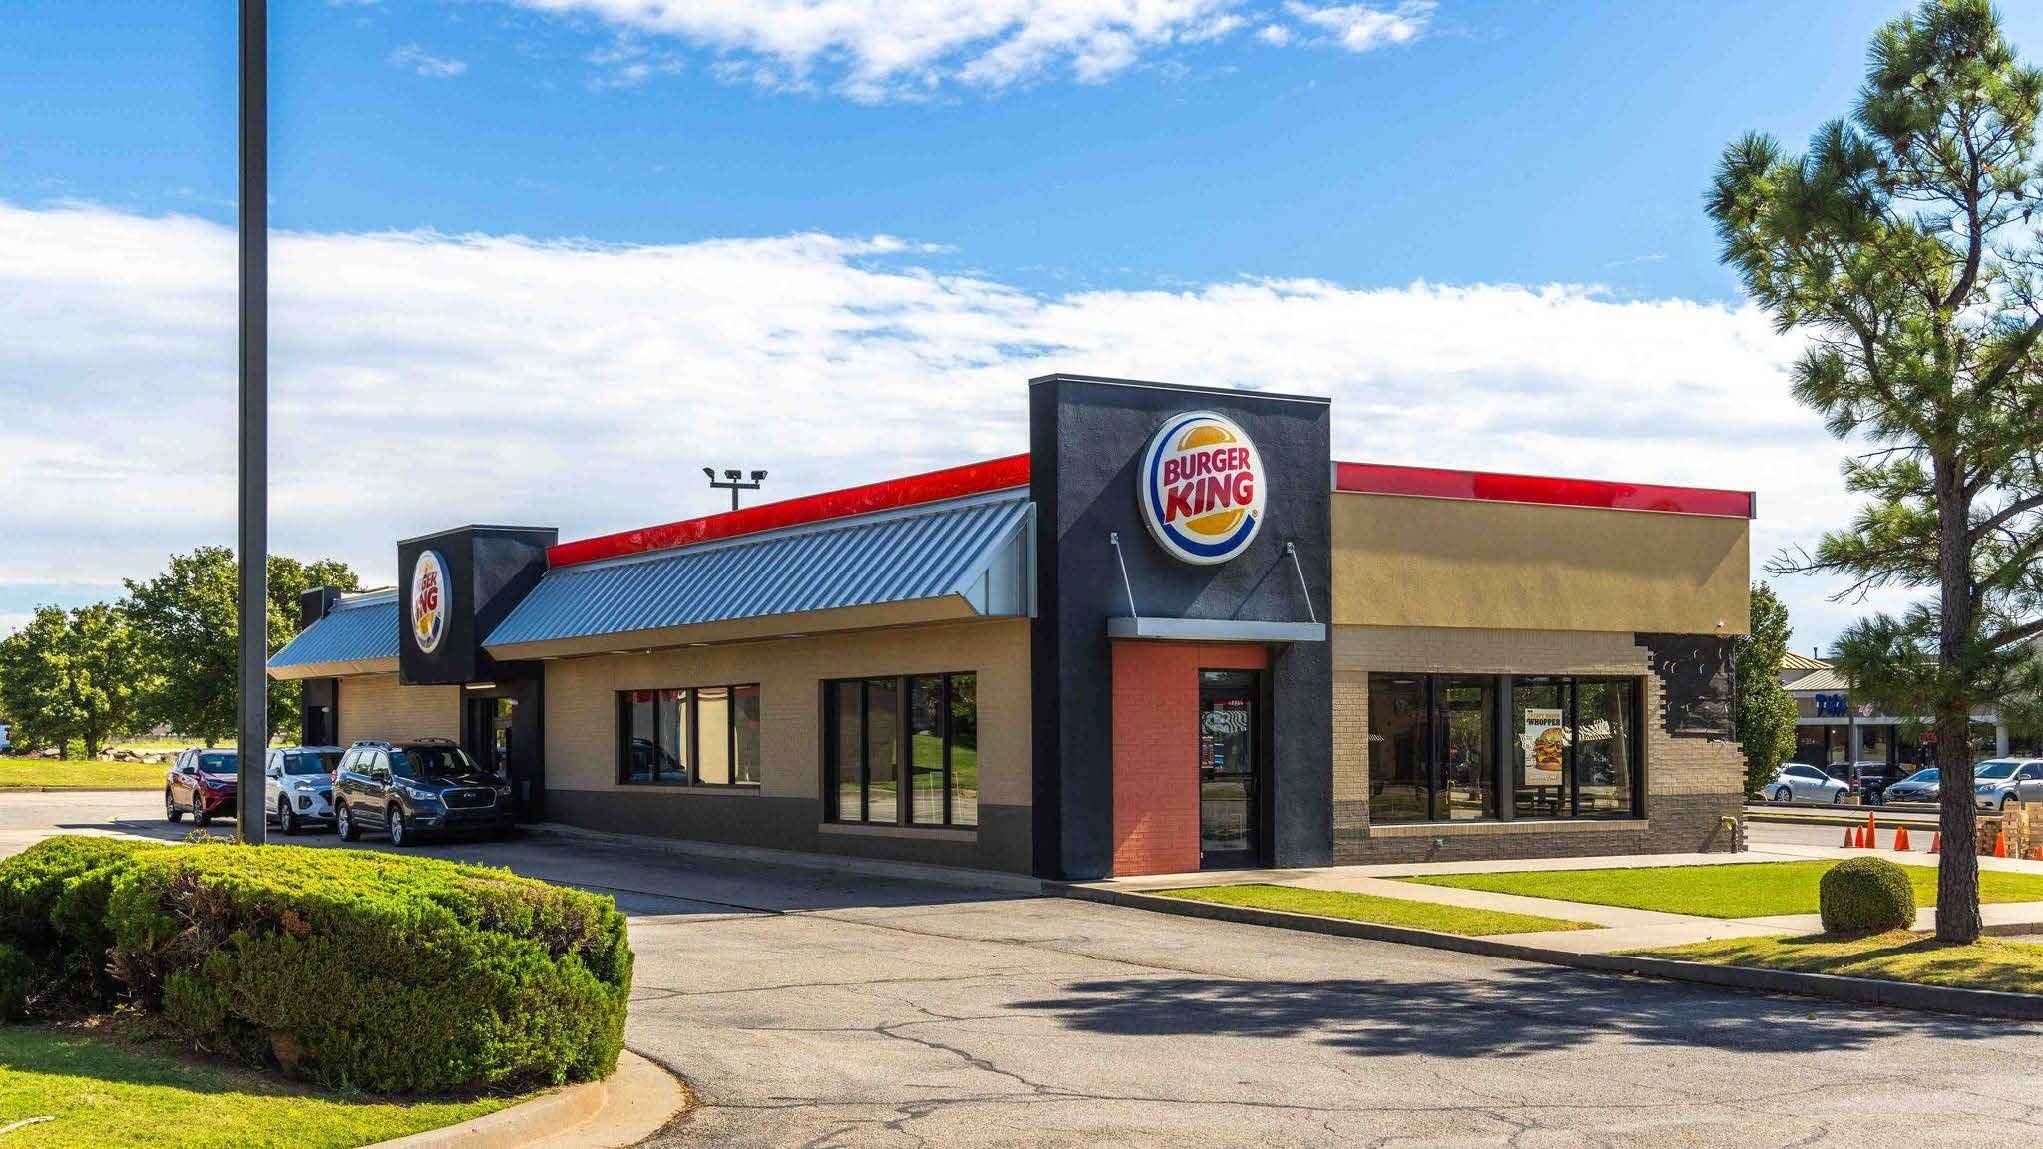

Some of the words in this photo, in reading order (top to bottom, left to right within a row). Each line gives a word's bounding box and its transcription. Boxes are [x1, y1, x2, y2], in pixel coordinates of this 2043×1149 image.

[1164, 447, 1250, 487] BURGER
[1164, 471, 1254, 524] KING
[1526, 718, 1561, 726] WHOPPER
